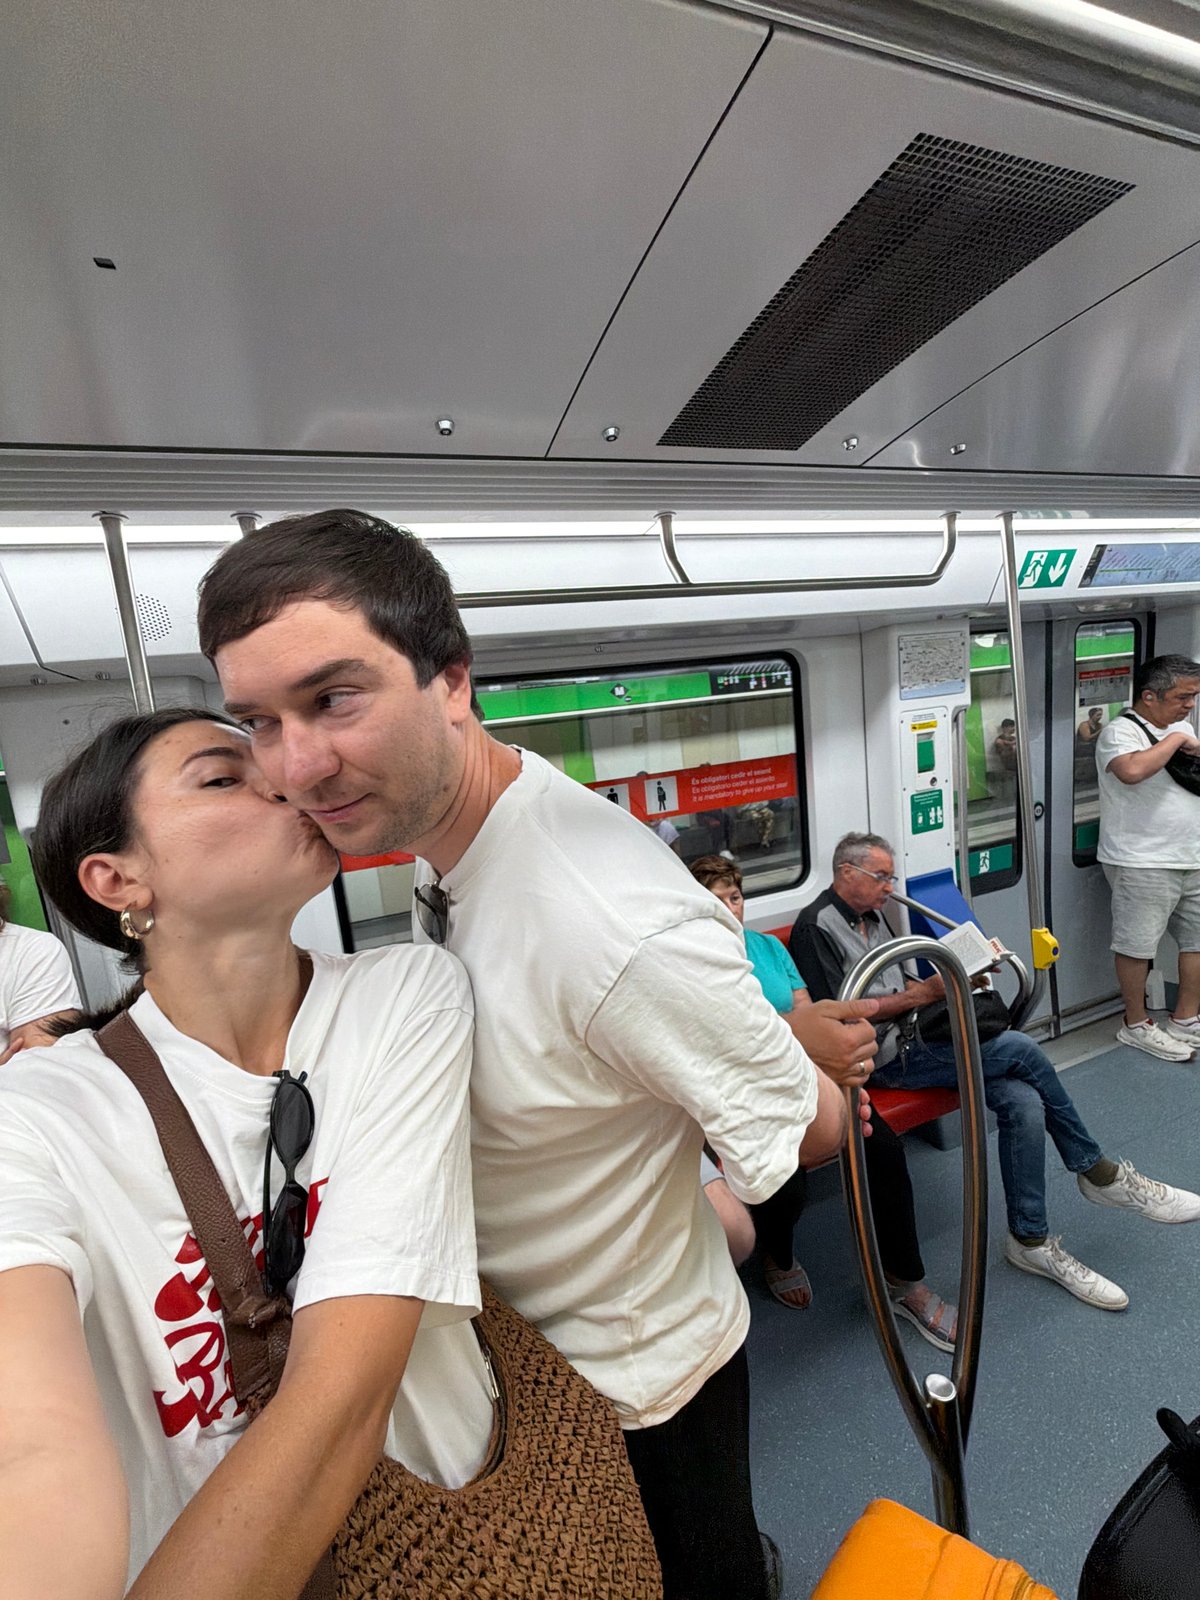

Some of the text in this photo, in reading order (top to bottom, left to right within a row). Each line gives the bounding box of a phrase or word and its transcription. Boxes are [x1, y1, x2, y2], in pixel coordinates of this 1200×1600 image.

[701, 774, 729, 783] obligatori
[701, 783, 731, 792] obligatorio
[704, 790, 734, 800] mandatory
